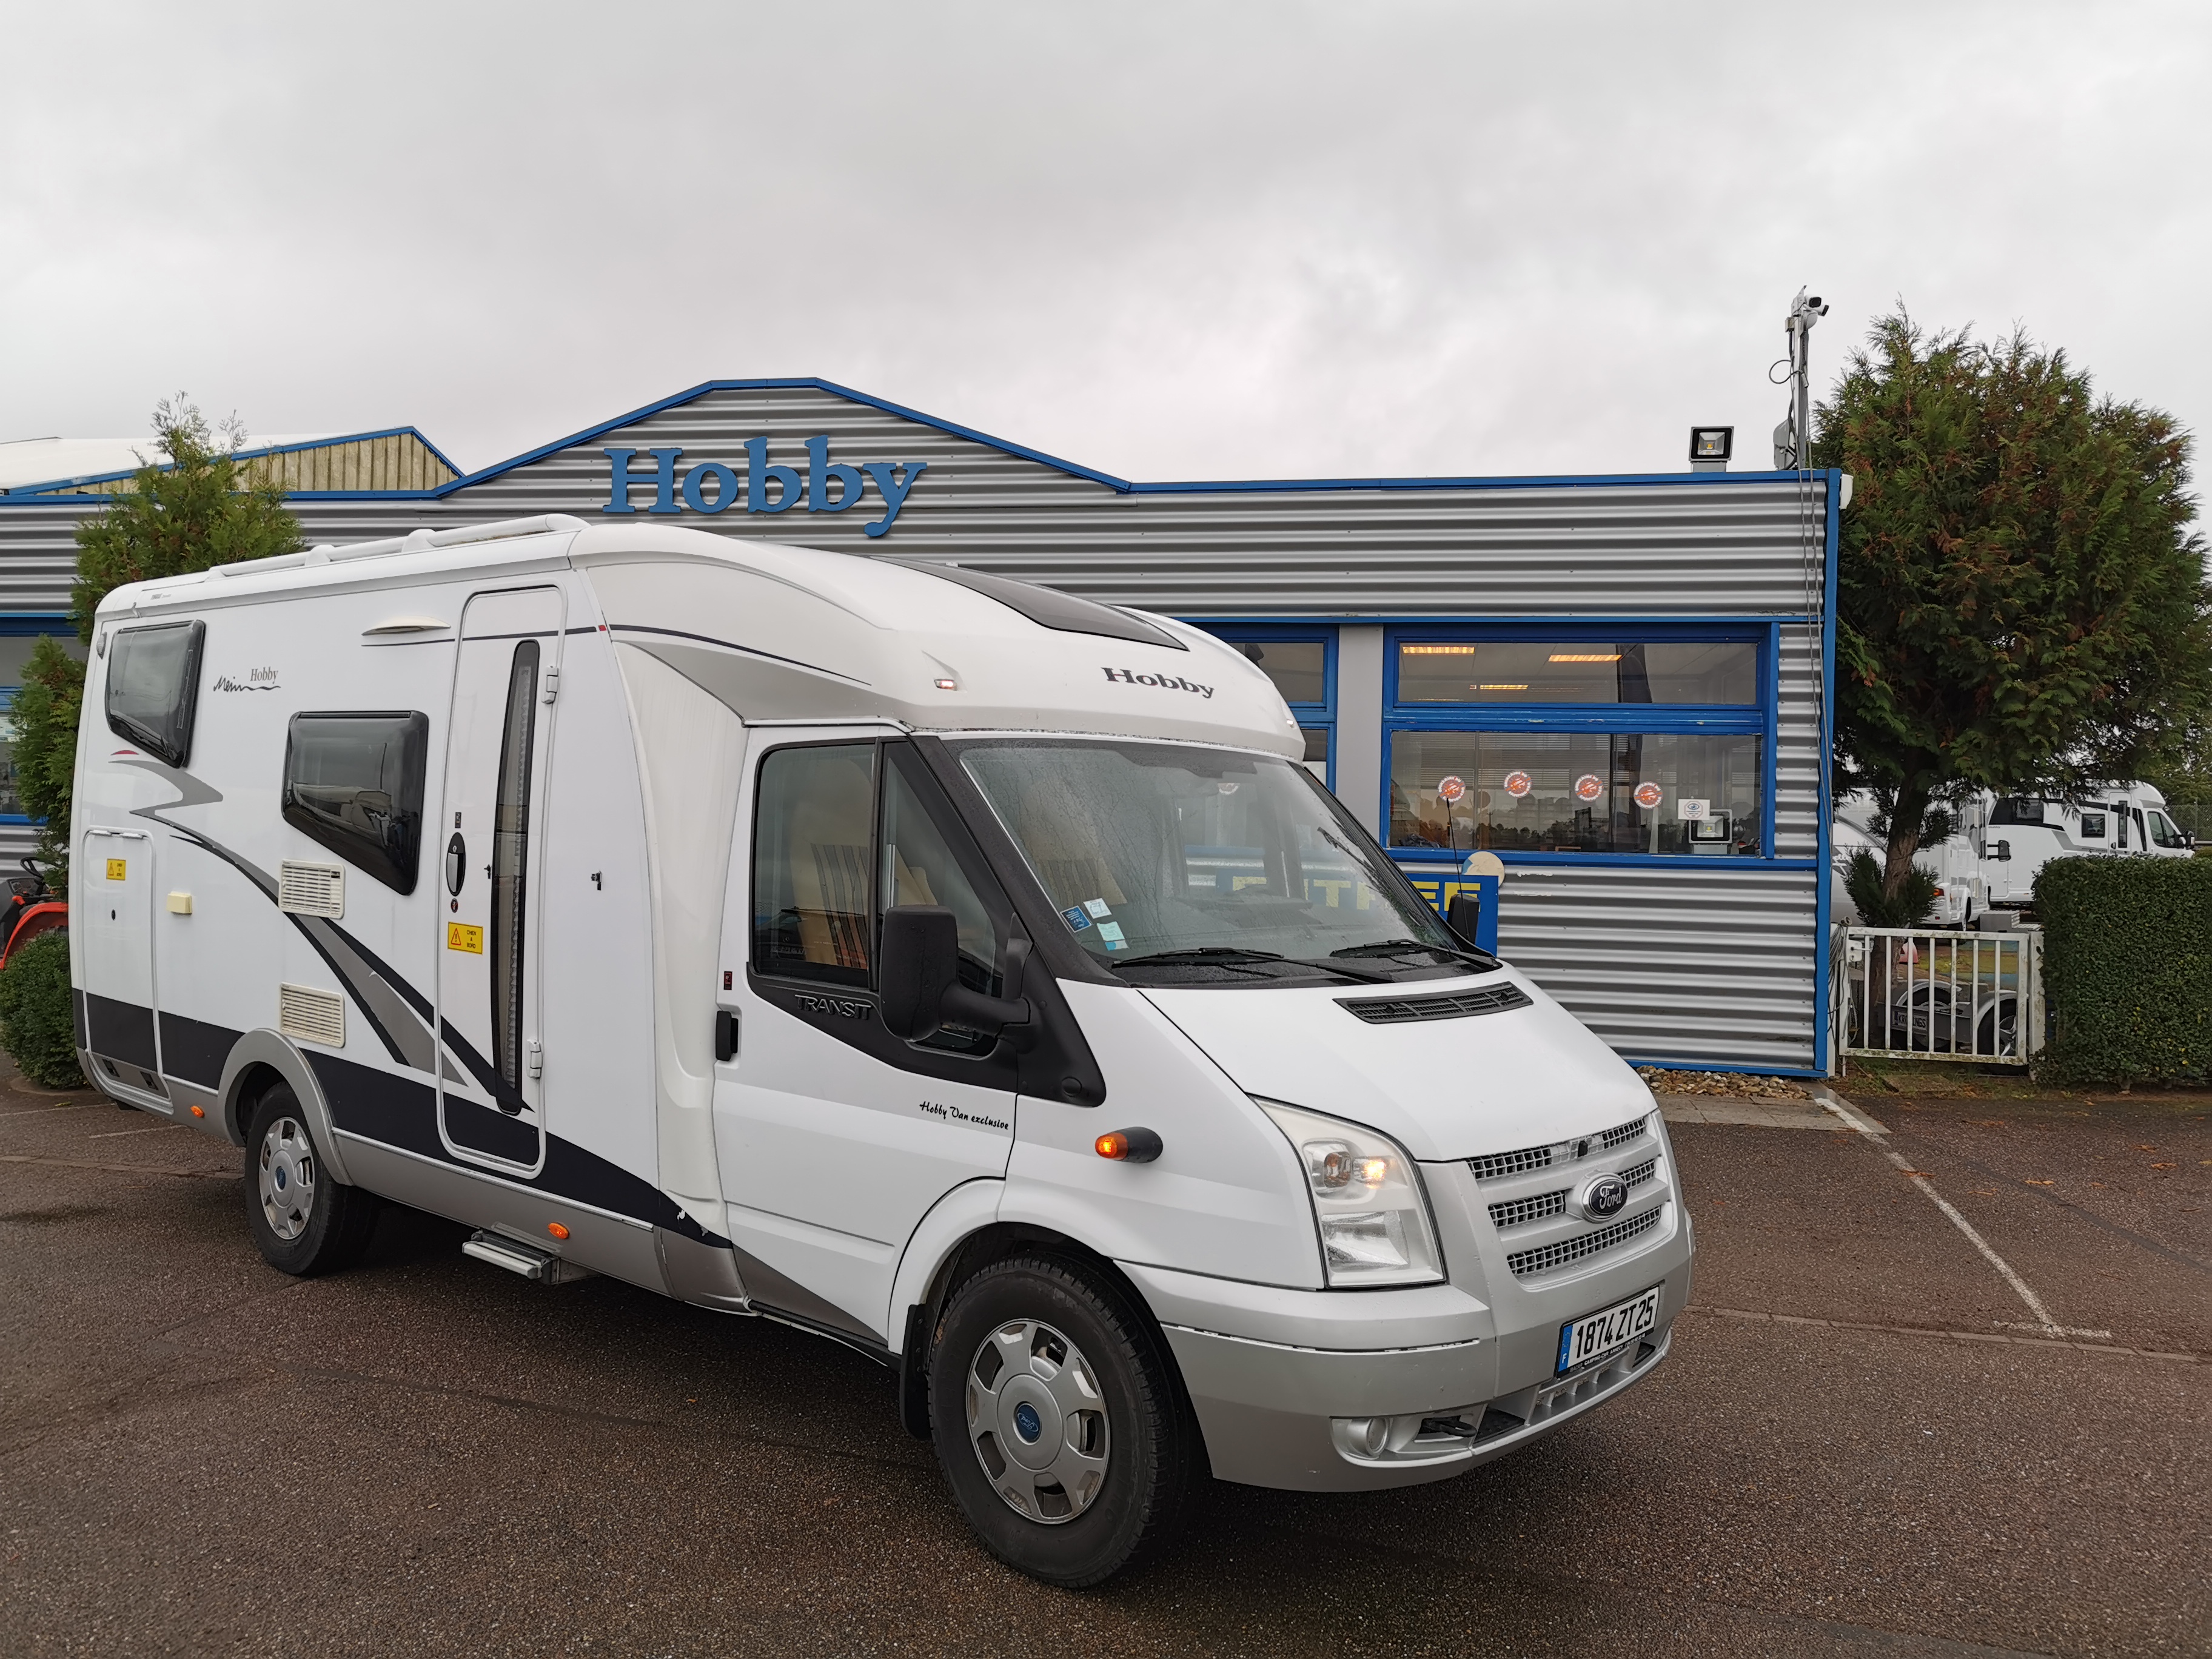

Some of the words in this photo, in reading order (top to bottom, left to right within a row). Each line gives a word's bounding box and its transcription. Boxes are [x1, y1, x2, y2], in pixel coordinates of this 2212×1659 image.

[603, 435, 927, 537] Hobby
[250, 666, 278, 685] Hobby
[1101, 667, 1215, 699] Hobby
[794, 994, 872, 1020] TRANSIT
[919, 1101, 947, 1120] Hobby
[950, 1106, 968, 1121] Van
[971, 1116, 1009, 1130] exclusive
[1599, 1184, 1623, 1210] Ford
[1561, 1353, 1567, 1364] F
